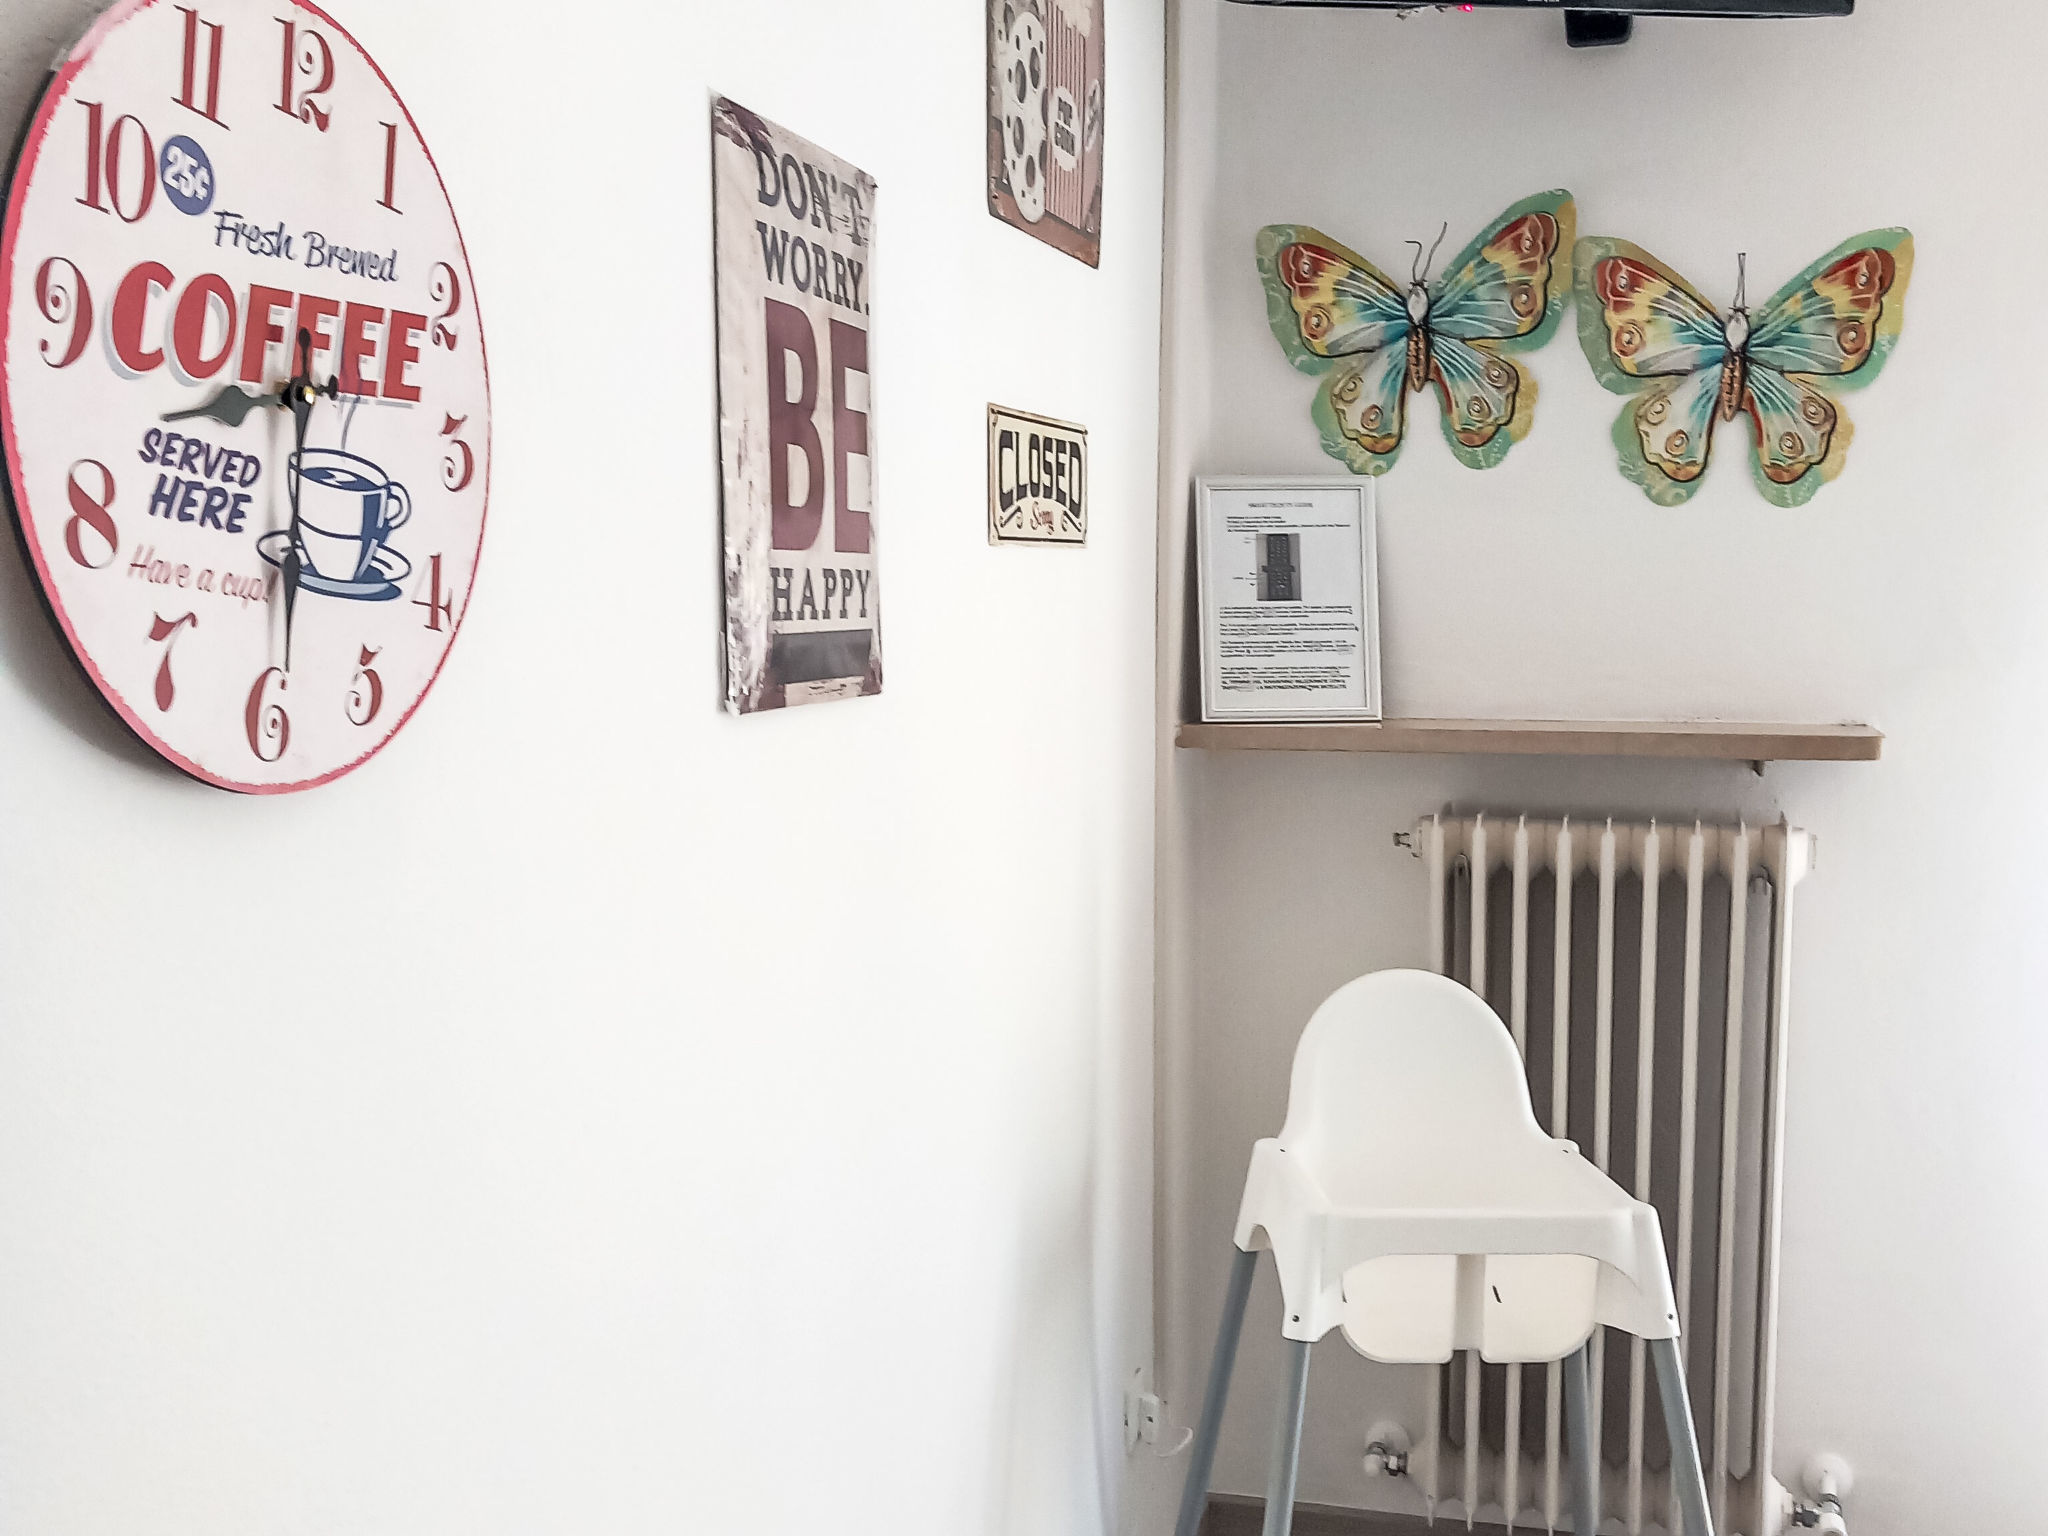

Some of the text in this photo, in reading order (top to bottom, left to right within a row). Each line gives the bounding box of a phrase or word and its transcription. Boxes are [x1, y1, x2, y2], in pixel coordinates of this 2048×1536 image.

[173, 4, 230, 131] 11
[272, 16, 334, 132] 12
[75, 98, 156, 223] 10
[375, 120, 403, 215] 1
[754, 148, 868, 247] DON'T
[214, 210, 398, 281] Fresh Brewed
[35, 257, 93, 369] 9
[108, 260, 428, 403] COFFEE
[430, 262, 461, 351] 2
[138, 427, 261, 488] SERVED
[440, 411, 475, 492] 3
[764, 296, 870, 554] BE
[66, 458, 119, 569] 8
[148, 473, 253, 534] HERE
[999, 429, 1082, 519] CLOSED
[197, 569, 216, 592] a
[411, 553, 452, 632] 4
[770, 567, 871, 621] HAPPY
[148, 611, 198, 712] 7
[345, 644, 383, 726] 5
[245, 666, 291, 762] 6
